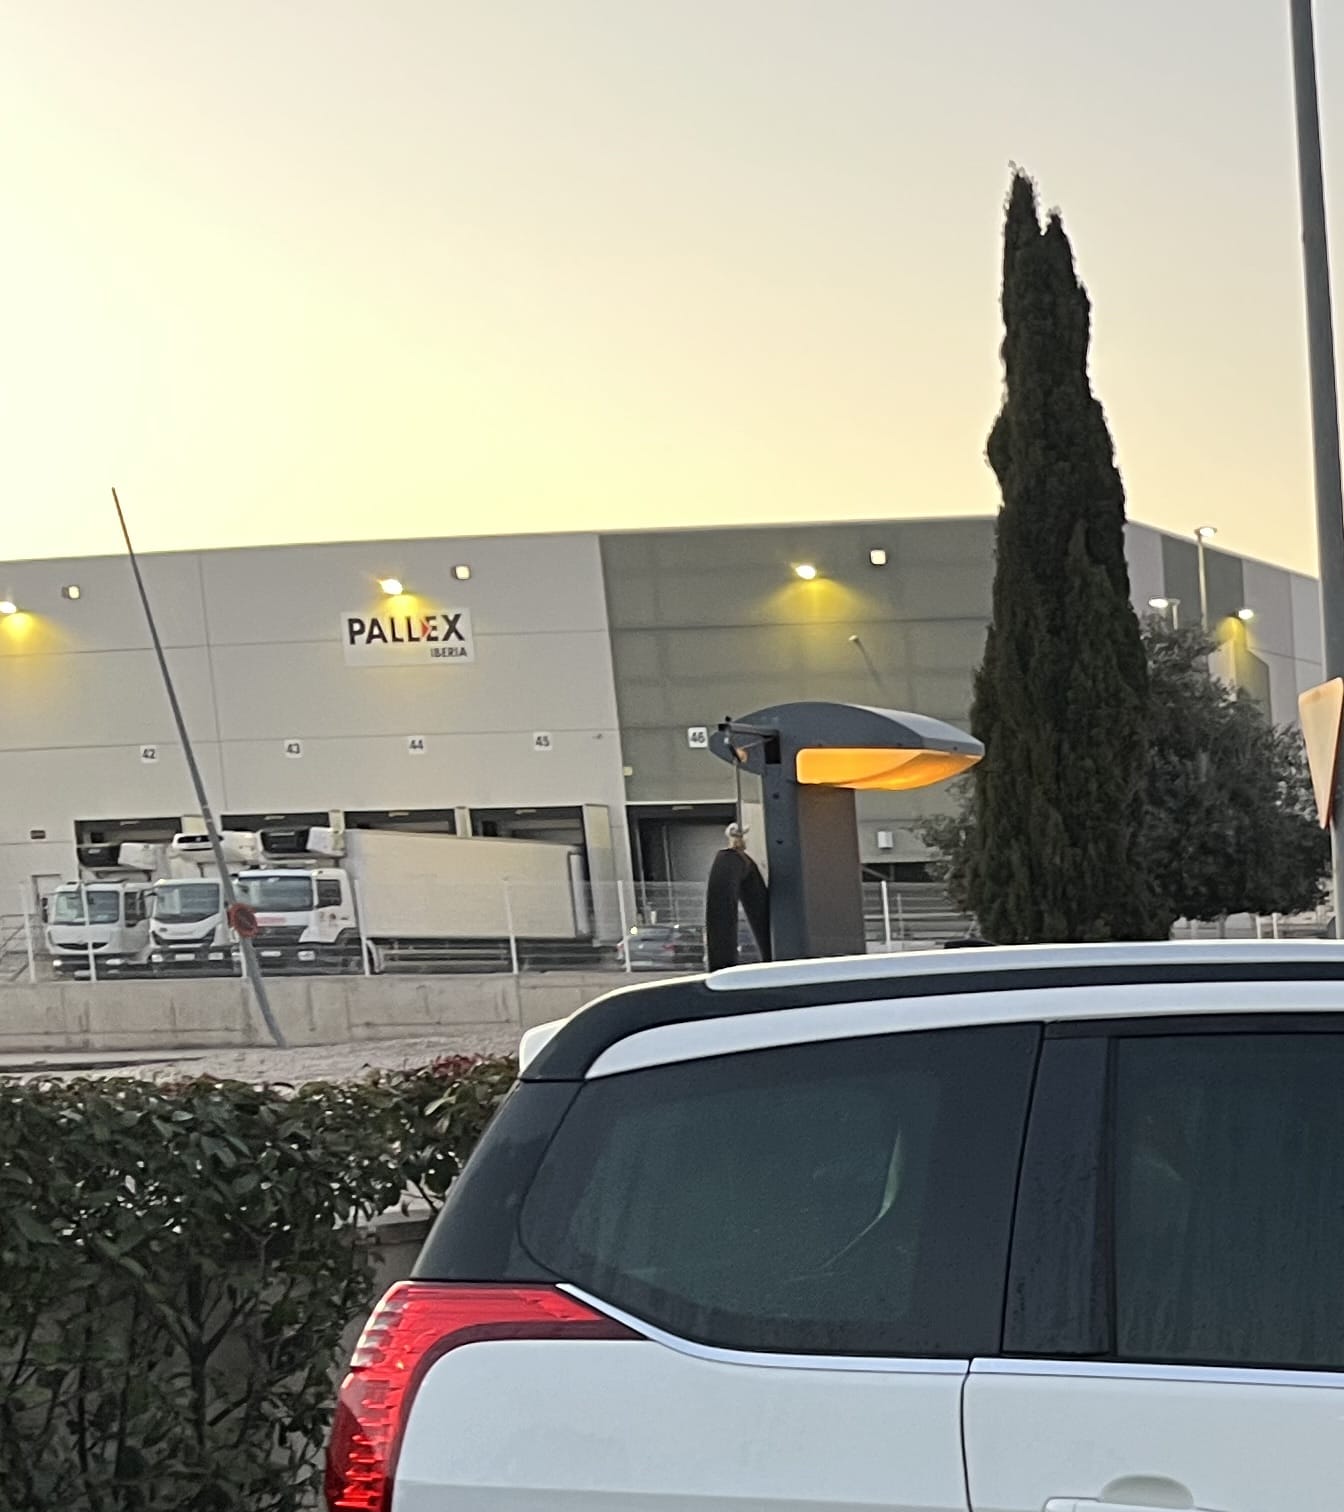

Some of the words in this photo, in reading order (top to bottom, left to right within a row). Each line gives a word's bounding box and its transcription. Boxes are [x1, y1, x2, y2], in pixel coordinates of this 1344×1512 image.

[347, 613, 465, 645] PALLEX
[430, 647, 467, 658] IBERIA
[535, 736, 550, 747] 45
[690, 731, 706, 744] 46
[286, 743, 301, 754] 43
[409, 738, 424, 750] 44
[142, 748, 156, 759] 42
